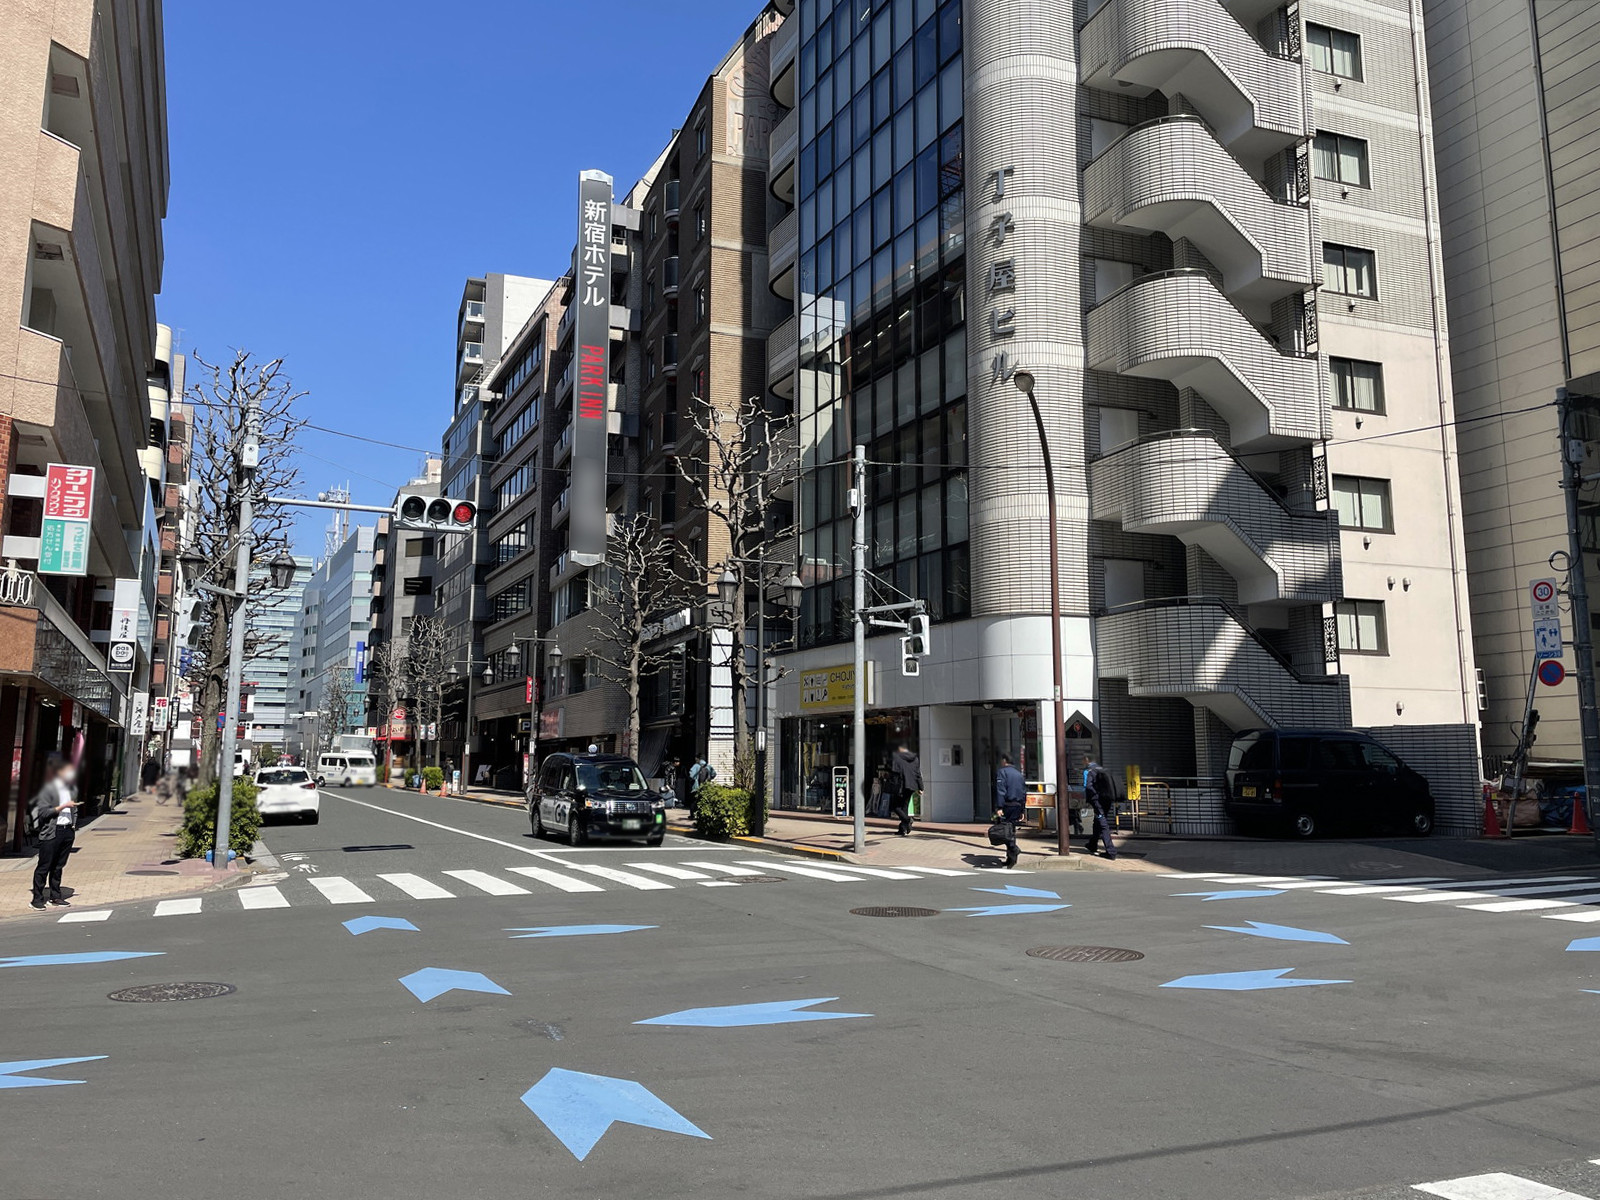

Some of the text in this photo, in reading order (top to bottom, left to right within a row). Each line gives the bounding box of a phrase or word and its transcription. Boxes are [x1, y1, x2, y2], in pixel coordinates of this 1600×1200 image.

[583, 199, 607, 307] 新宿ホテル
[579, 344, 605, 420] PARK INN
[1537, 586, 1550, 597] 30
[156, 698, 168, 708] 花
[522, 721, 531, 731] P
